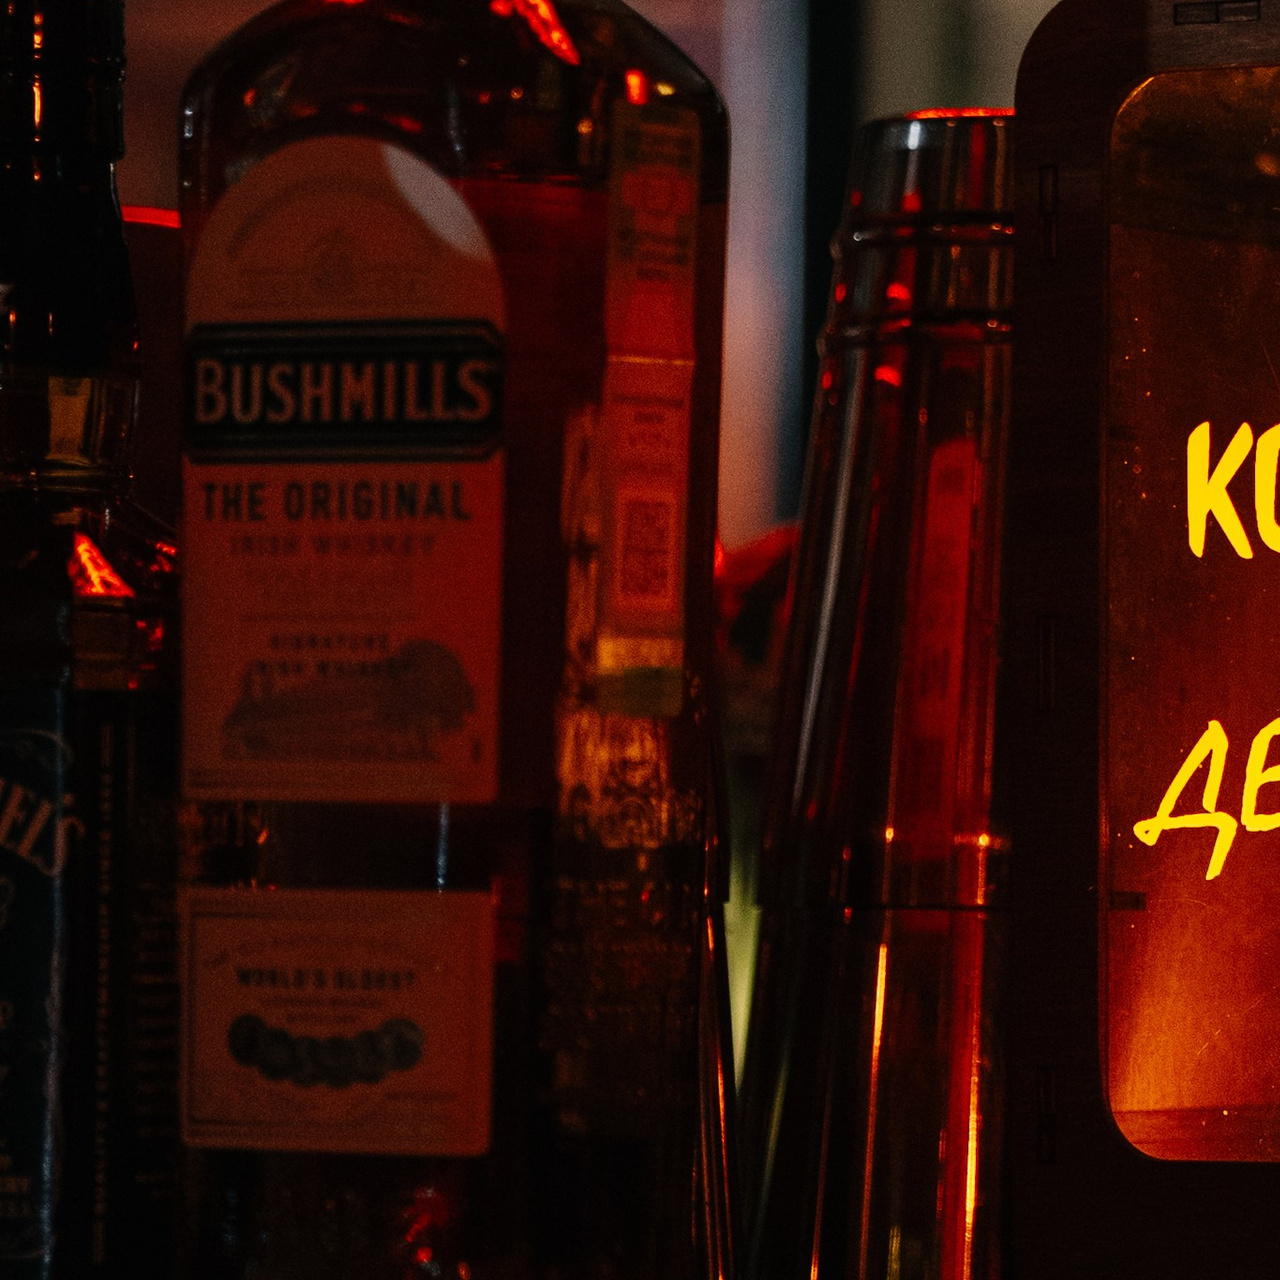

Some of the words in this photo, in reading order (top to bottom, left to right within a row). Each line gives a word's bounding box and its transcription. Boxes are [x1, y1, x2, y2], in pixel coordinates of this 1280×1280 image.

[195, 357, 494, 425] BUSHMILLS
[203, 481, 266, 521] THE
[283, 481, 471, 522] ORIGINAL
